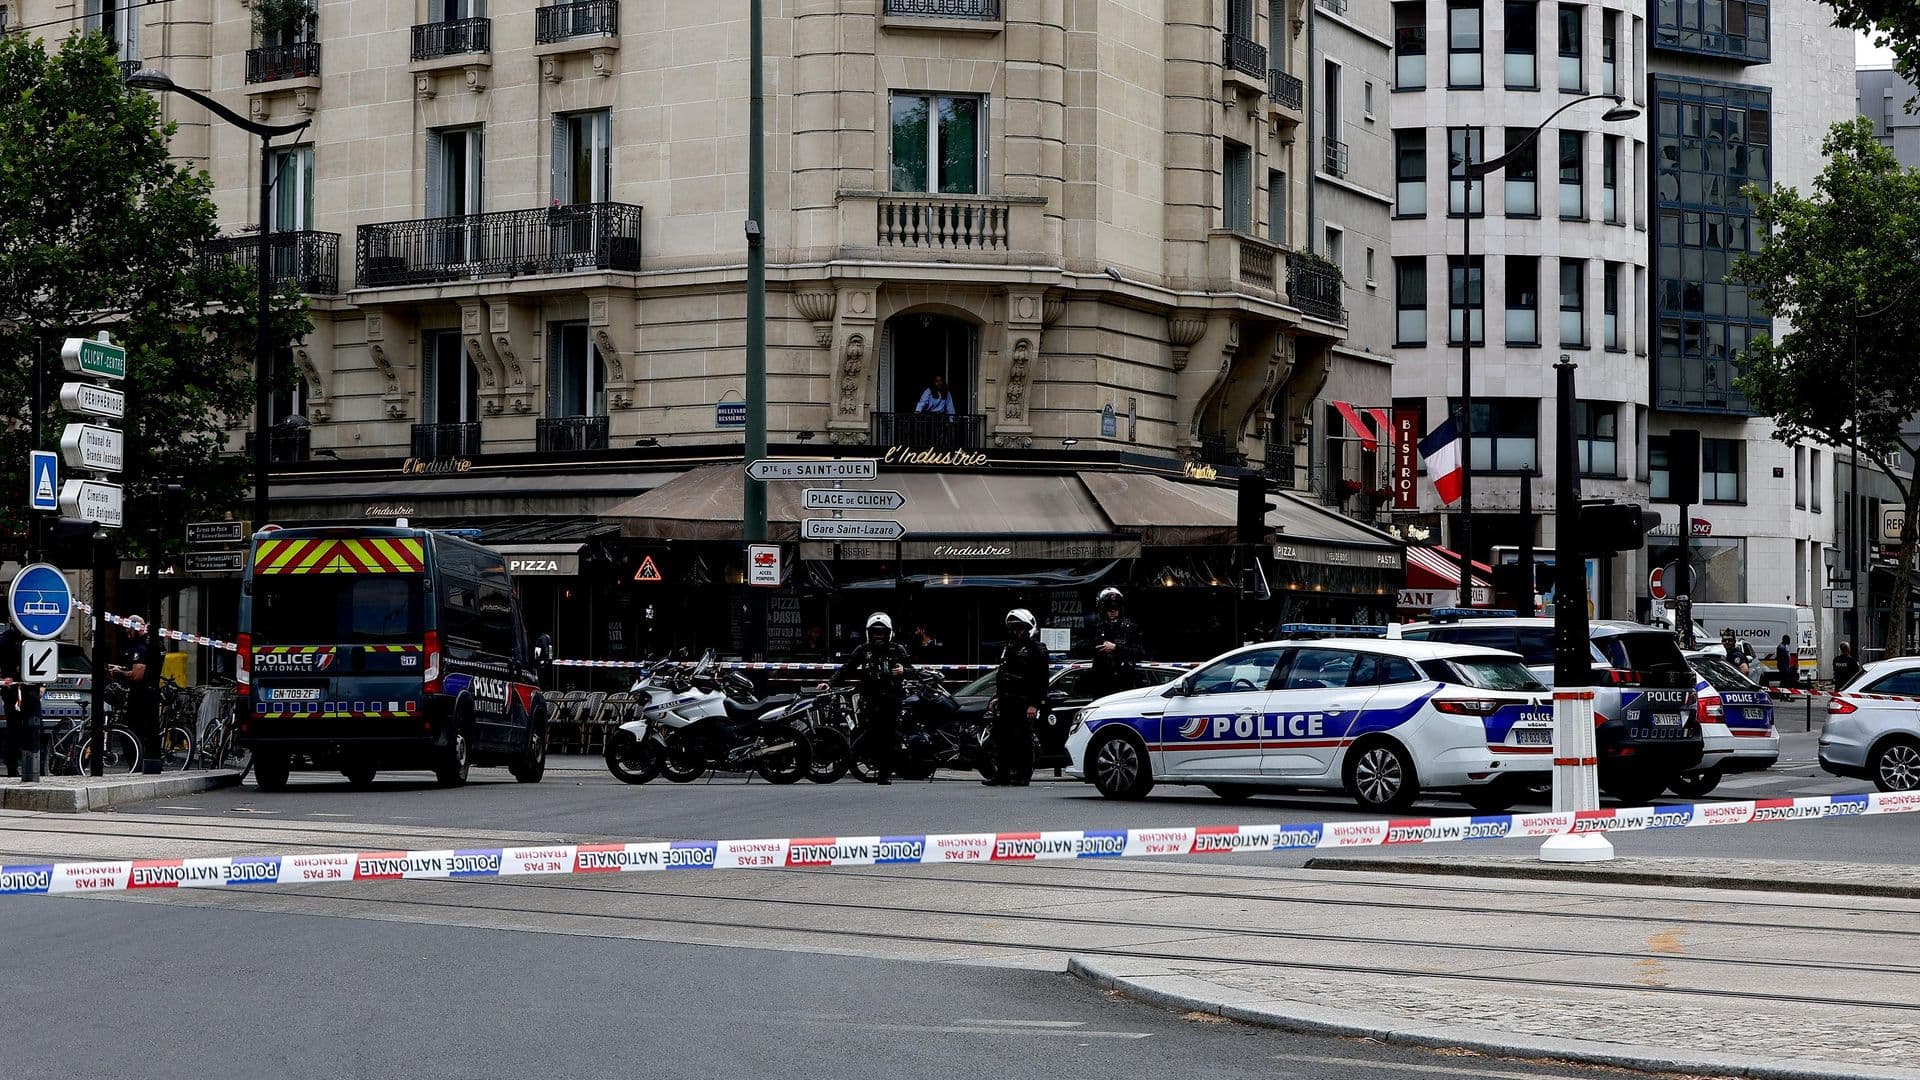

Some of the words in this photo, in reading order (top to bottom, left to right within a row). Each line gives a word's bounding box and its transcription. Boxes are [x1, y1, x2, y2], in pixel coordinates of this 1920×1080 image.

[86, 432, 104, 447] Tribunal
[105, 436, 111, 448] de
[86, 448, 102, 462] Grande
[102, 451, 121, 465] Instance
[1401, 420, 1411, 501] BISTROT
[797, 465, 870, 475] SAINT-OUEN
[87, 489, 109, 503] Cimetière
[811, 494, 843, 504] PLACE
[857, 495, 893, 505] CLICHY
[86, 505, 95, 517] des
[96, 506, 121, 522] Batignolles
[812, 524, 834, 534] Gare
[837, 524, 894, 535] Saint-Lazare
[1692, 524, 1711, 533] SNCF
[1277, 546, 1297, 557] PIZZA
[1377, 554, 1396, 564] PASTA
[135, 564, 175, 575] PIA
[510, 560, 558, 571] PIZZA
[771, 597, 801, 609] PIZZA
[1050, 600, 1082, 614] PIZZA
[254, 654, 313, 665] POLICE
[473, 676, 504, 700] POLICE
[1647, 691, 1682, 702] POLICE
[1726, 694, 1753, 703] POLICE
[474, 699, 503, 715] NATIONALE
[1520, 712, 1551, 721] POLICE
[1212, 713, 1324, 739] POLICE
[1703, 806, 1748, 817] FRANCHIR
[1755, 805, 1821, 820] NATIONALE
[1823, 801, 1865, 814] POLICE
[1521, 816, 1568, 826] FRANCHIR
[1576, 816, 1646, 832] NATIONALE
[1646, 812, 1691, 827] POLICE
[1333, 826, 1381, 836] FRANCHIR
[1389, 826, 1460, 842] NATIONALE
[1463, 823, 1509, 837] POLICE
[937, 837, 987, 847] FRANCHIR
[1138, 831, 1188, 842] FRANCHIR
[1197, 832, 1269, 849] NATIONALE
[1272, 830, 1319, 848] POLICE
[728, 843, 780, 853] FRANCHIR
[872, 841, 921, 858] POLICE
[998, 839, 1072, 857] NATIONALE
[1076, 836, 1123, 853] POLICE
[1145, 844, 1165, 854] PAS
[1166, 843, 1180, 852] NE
[515, 849, 568, 860] FRANCHIR
[663, 847, 713, 864] POLICE
[791, 844, 868, 861] NATIONALE
[944, 850, 964, 860] PAS
[966, 849, 980, 859] NE
[294, 855, 349, 867] FRANCHIR
[447, 854, 499, 871] POLICE
[578, 850, 658, 869] NATIONALE
[737, 855, 757, 866] PAS
[759, 854, 774, 864] NE
[66, 864, 122, 876] FRANCHIR
[223, 861, 277, 879] POLICE
[360, 857, 442, 875] NATIONALE
[524, 862, 545, 871] PAS
[547, 861, 561, 870] NE
[135, 866, 218, 883] NATIONALE
[303, 869, 323, 879] PAS
[327, 868, 341, 878] NE
[0, 873, 47, 888] POLIC
[75, 878, 97, 889] PAS
[100, 877, 115, 887] NE
